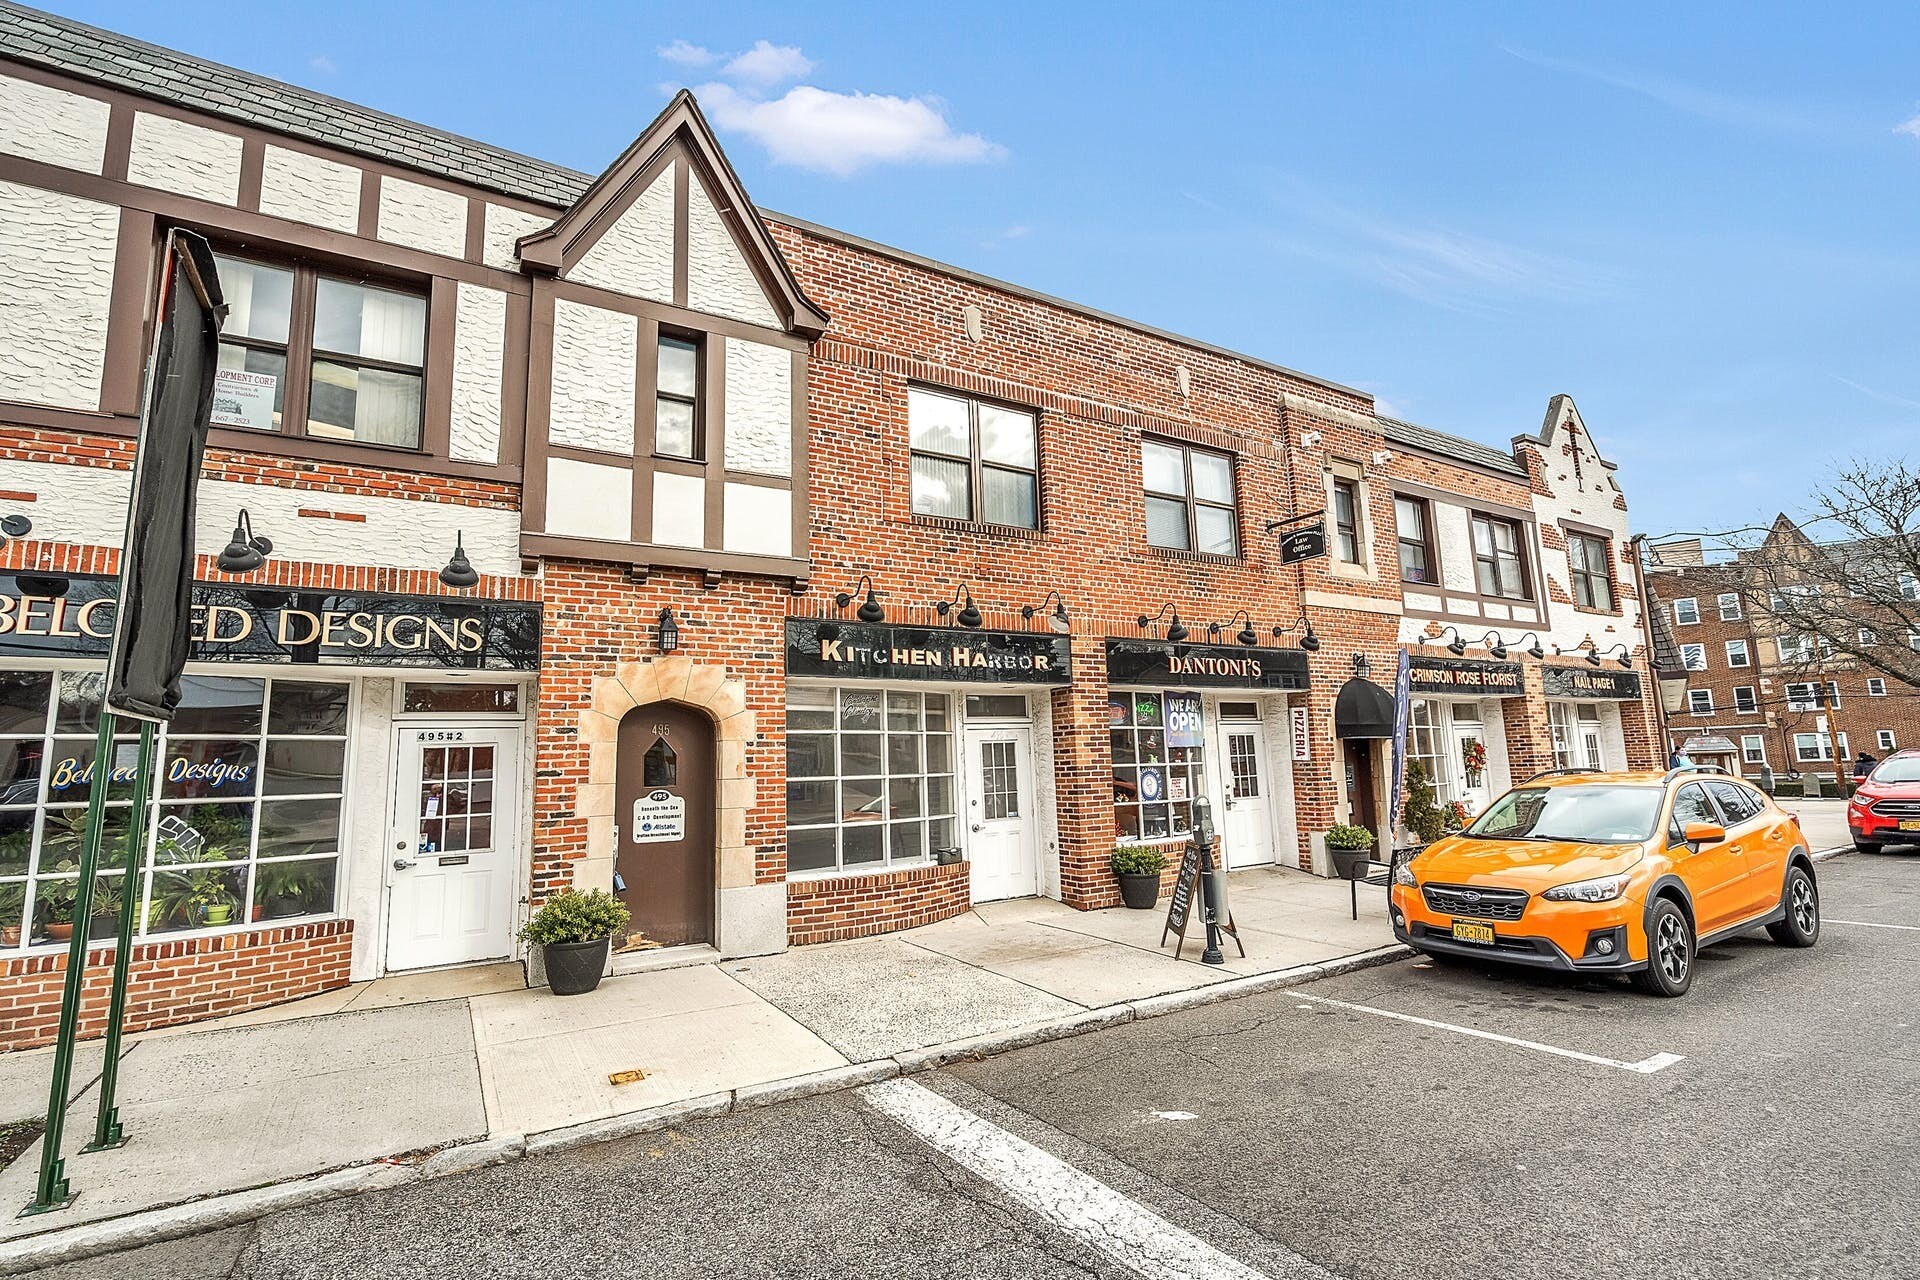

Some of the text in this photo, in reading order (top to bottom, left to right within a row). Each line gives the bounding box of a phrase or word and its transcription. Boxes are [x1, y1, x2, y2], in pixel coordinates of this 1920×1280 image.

[216, 370, 253, 383] OPMENT
[0, 594, 484, 653] BELOED DESIGNS
[820, 639, 942, 667] KITCHEN
[1168, 656, 1262, 677] DANTONI'S
[1408, 668, 1517, 687] CRIMSON ROSE FLORIST
[1572, 676, 1592, 689] NAIL
[1135, 703, 1154, 716] IZZA
[1168, 699, 1184, 712] WE
[651, 724, 670, 736] 495
[1169, 712, 1202, 732] OPEN
[1293, 710, 1306, 758] PIZZERIA
[168, 757, 251, 788] Designs
